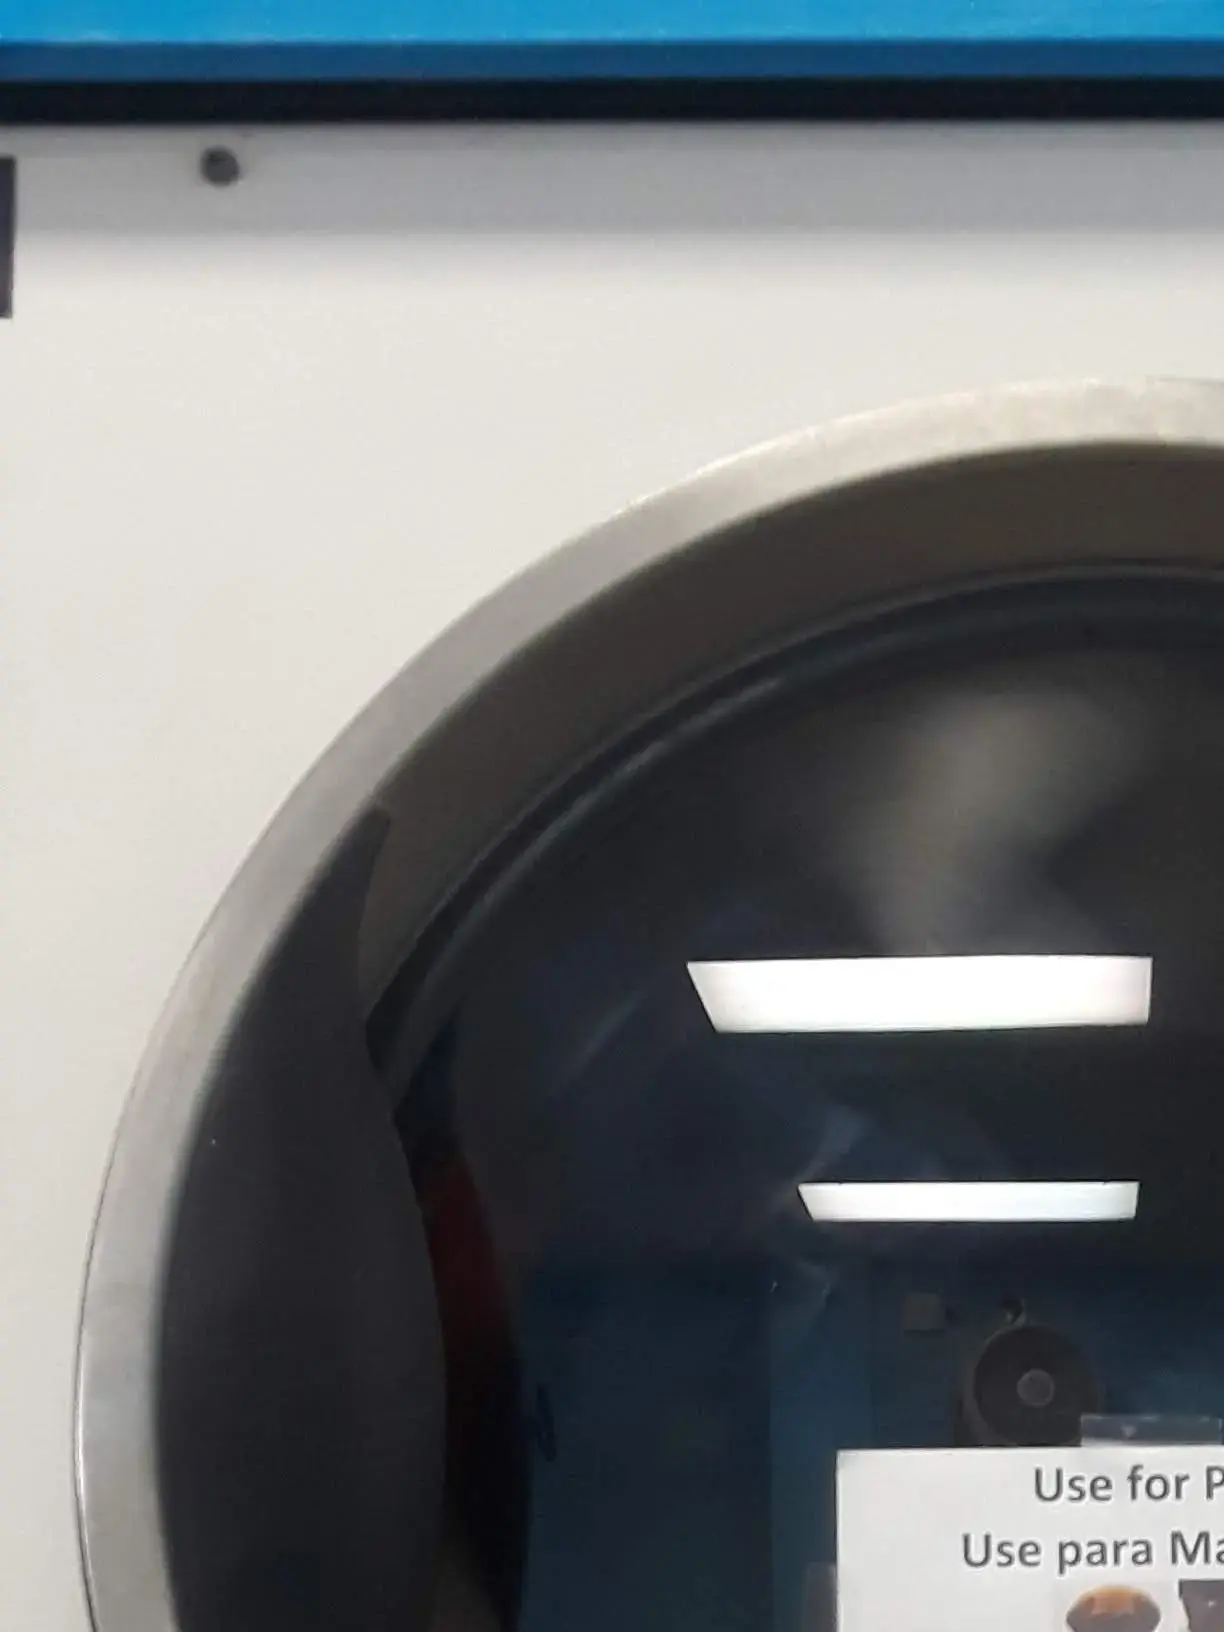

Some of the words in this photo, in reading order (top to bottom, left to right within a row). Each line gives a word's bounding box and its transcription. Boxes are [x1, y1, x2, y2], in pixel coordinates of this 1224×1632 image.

[1033, 1467, 1114, 1502] Use
[1127, 1464, 1190, 1502] for
[962, 1532, 1043, 1568] Use
[1057, 1537, 1154, 1575] para
